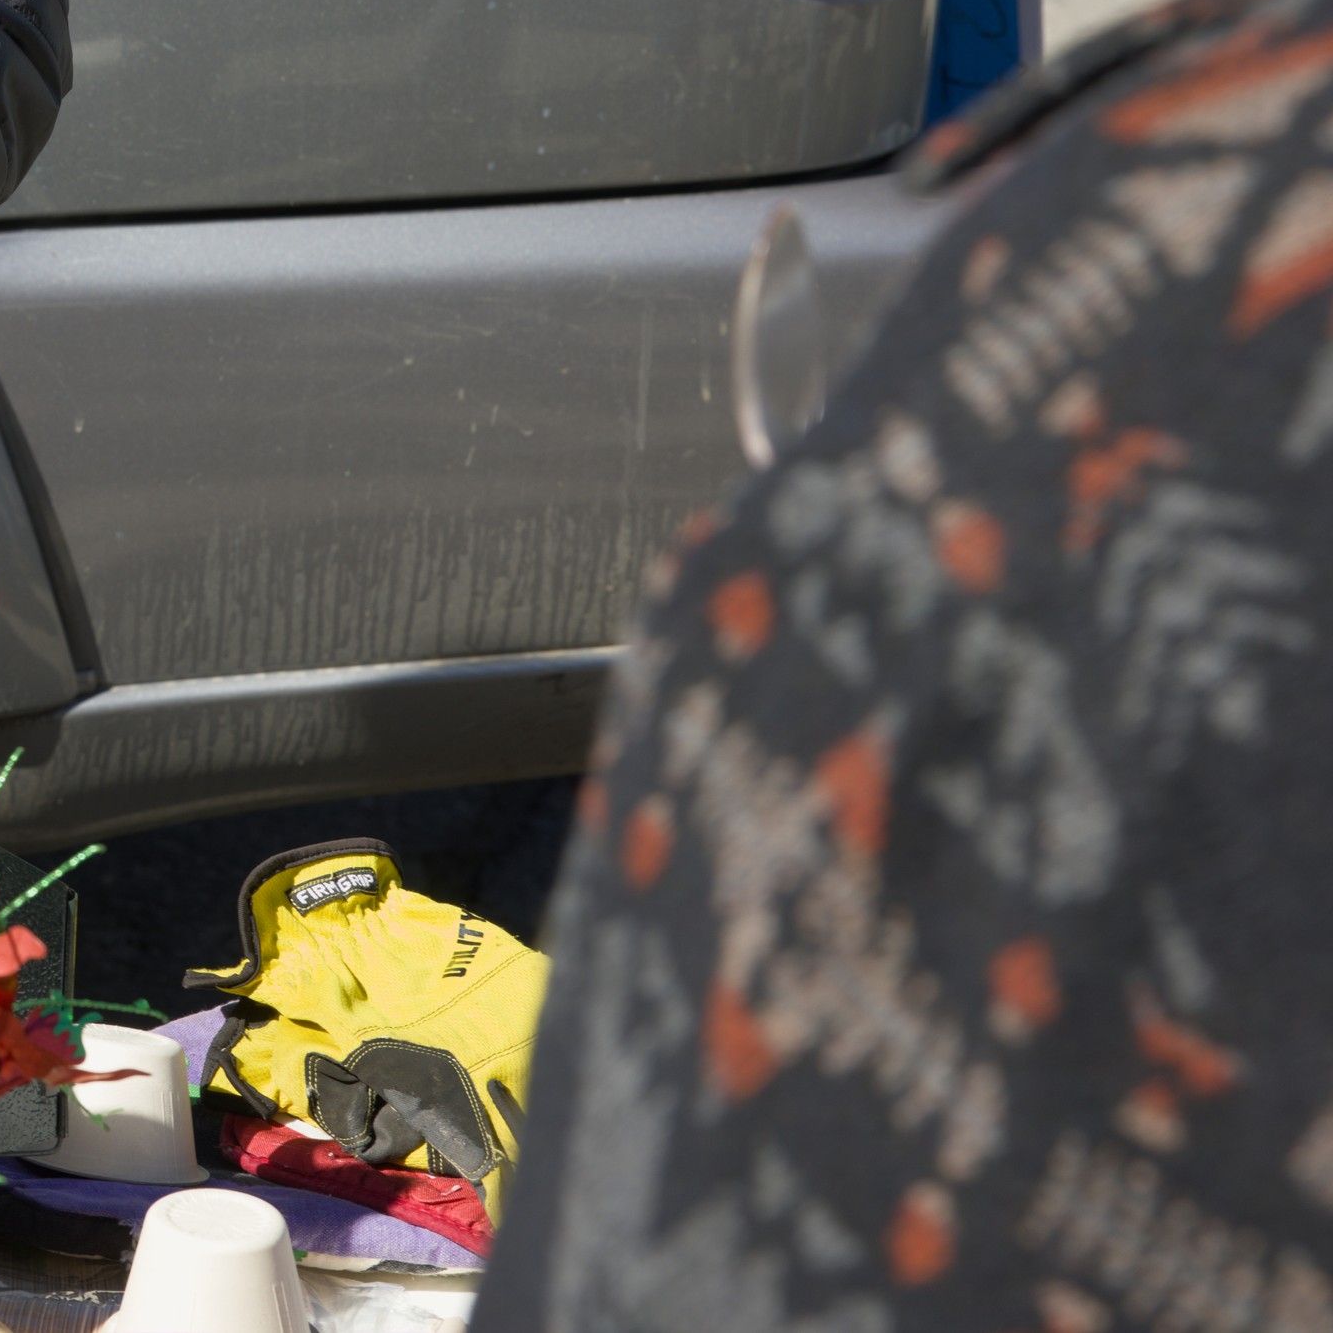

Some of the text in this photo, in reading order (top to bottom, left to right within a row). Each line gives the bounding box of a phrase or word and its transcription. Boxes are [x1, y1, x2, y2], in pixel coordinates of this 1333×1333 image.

[295, 873, 375, 905] FIRM GRIP
[441, 912, 488, 979] UTILITY
